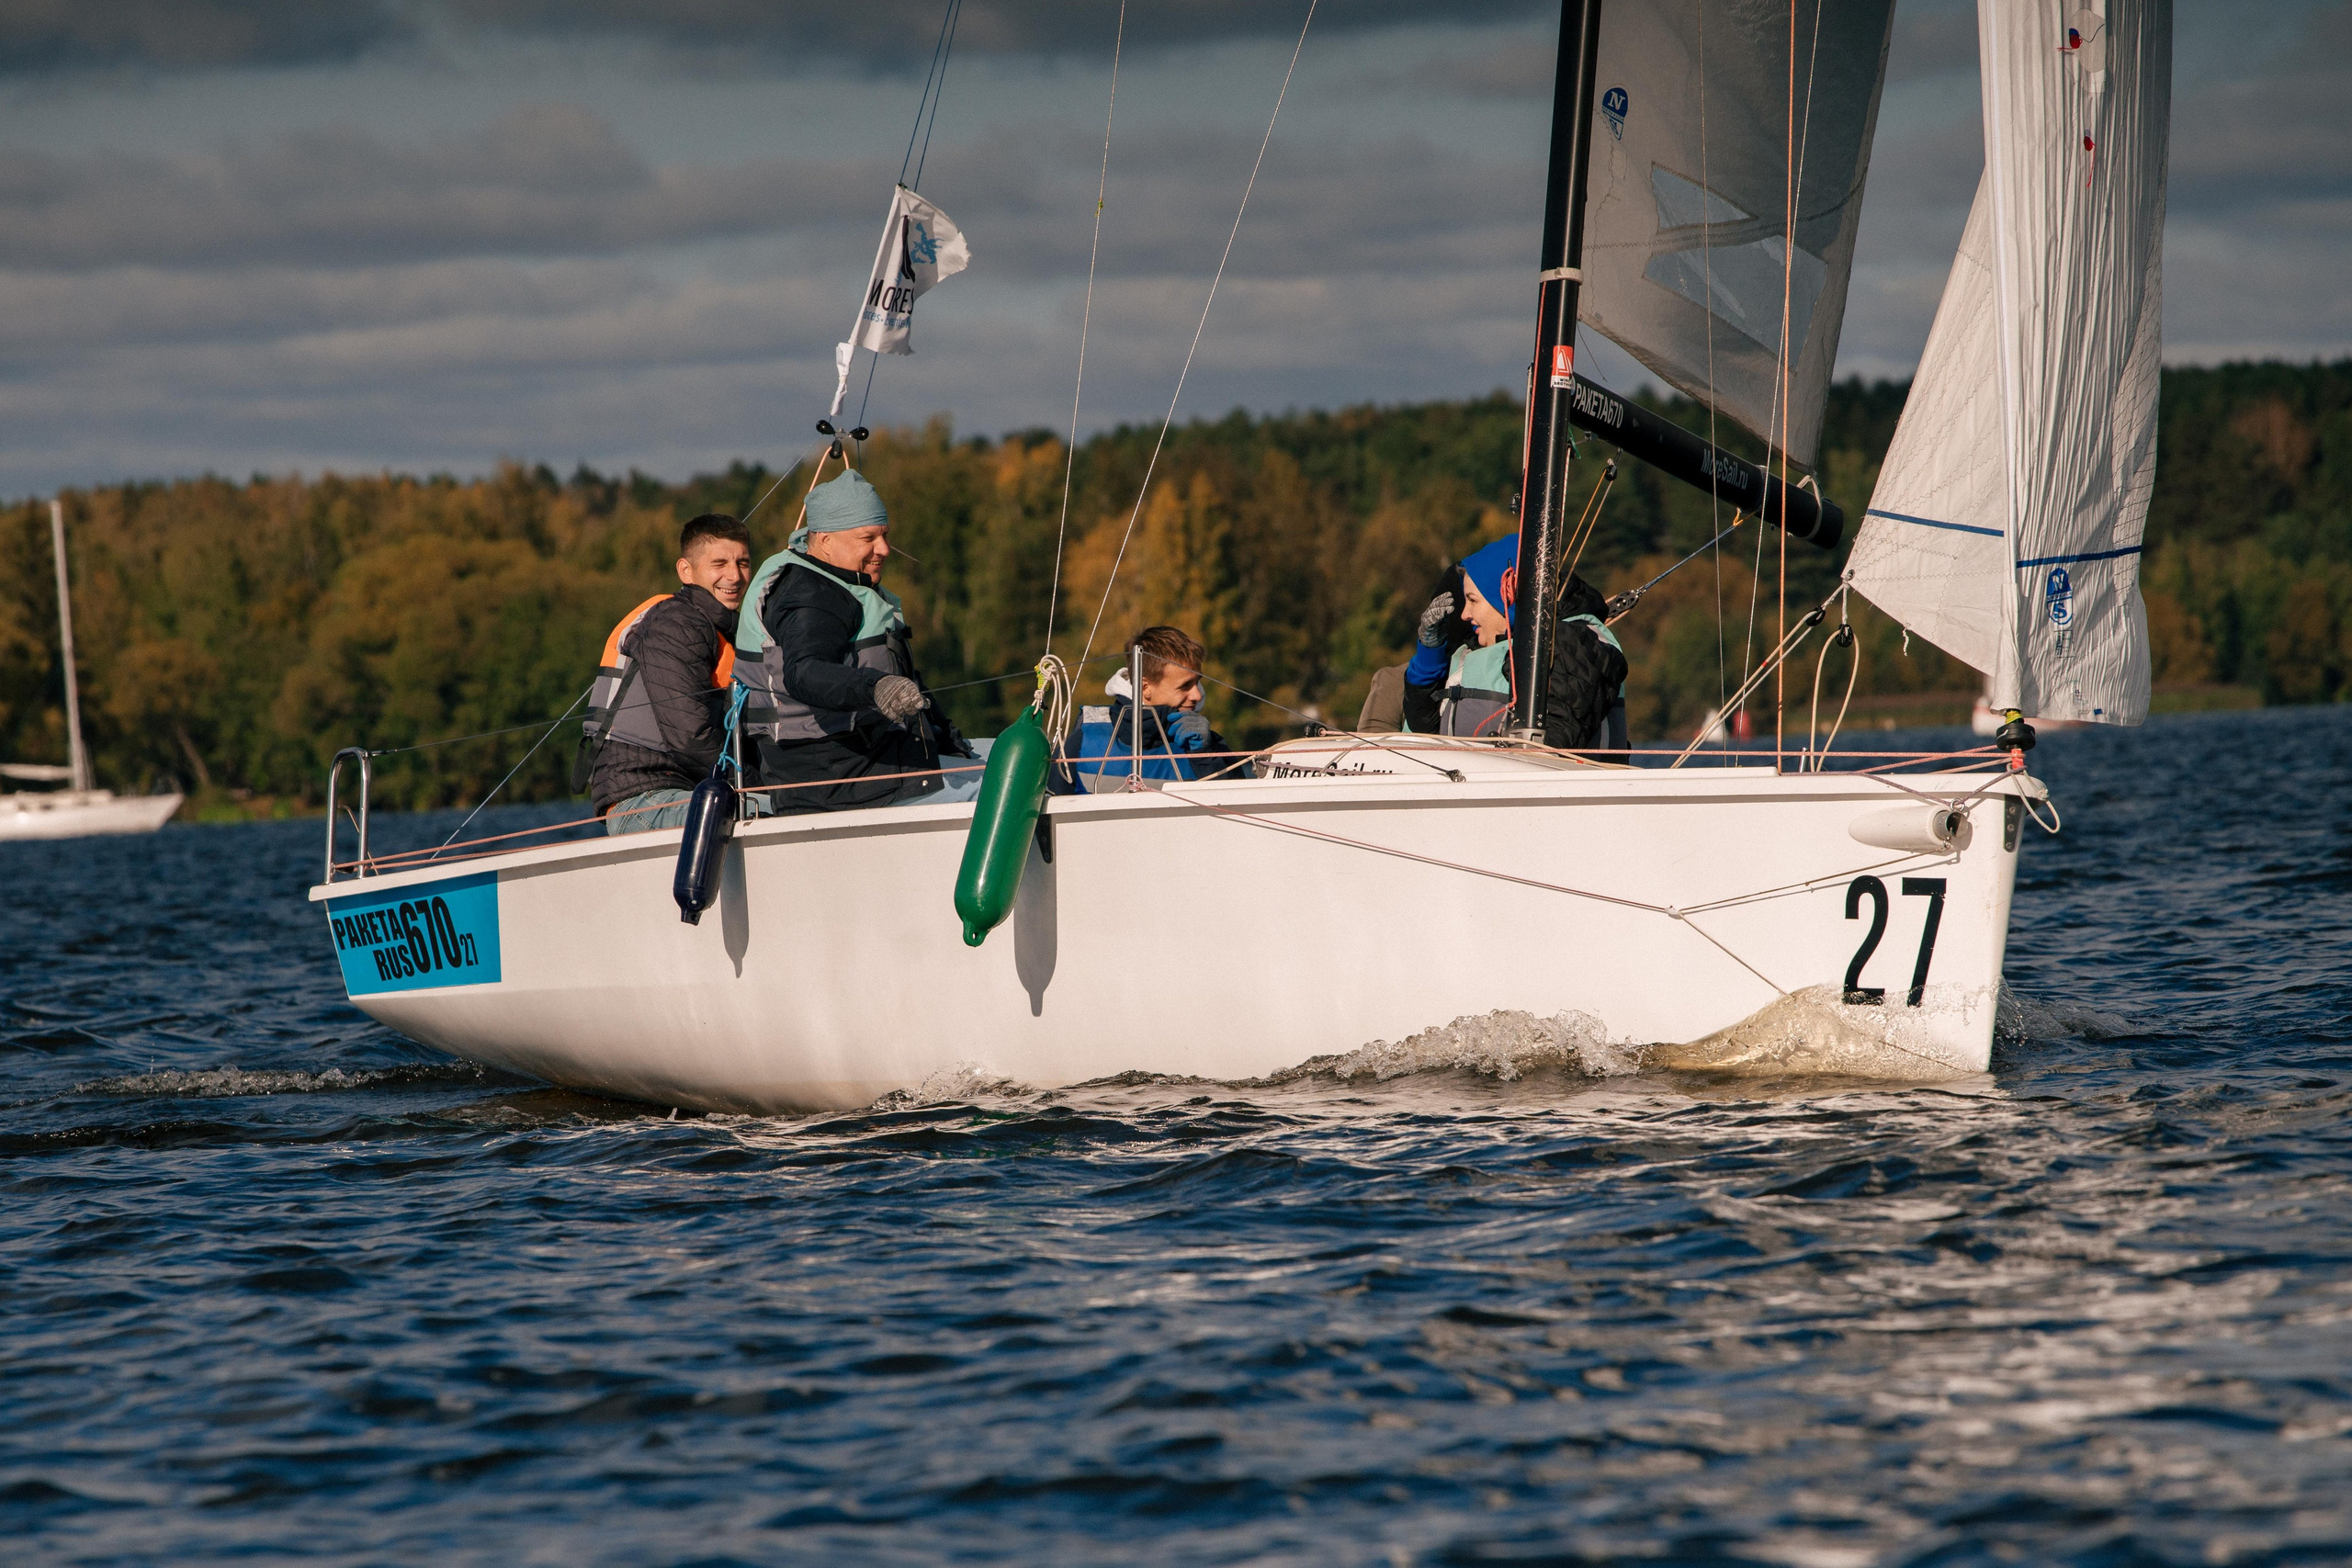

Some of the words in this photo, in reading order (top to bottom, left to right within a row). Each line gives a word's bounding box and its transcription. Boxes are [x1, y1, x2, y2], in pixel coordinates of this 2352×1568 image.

[1607, 90, 1626, 111] N
[1572, 382, 1624, 429] PAKETA670
[373, 943, 415, 982] RUS
[459, 932, 480, 967] 27
[1841, 874, 1948, 1008] 27
